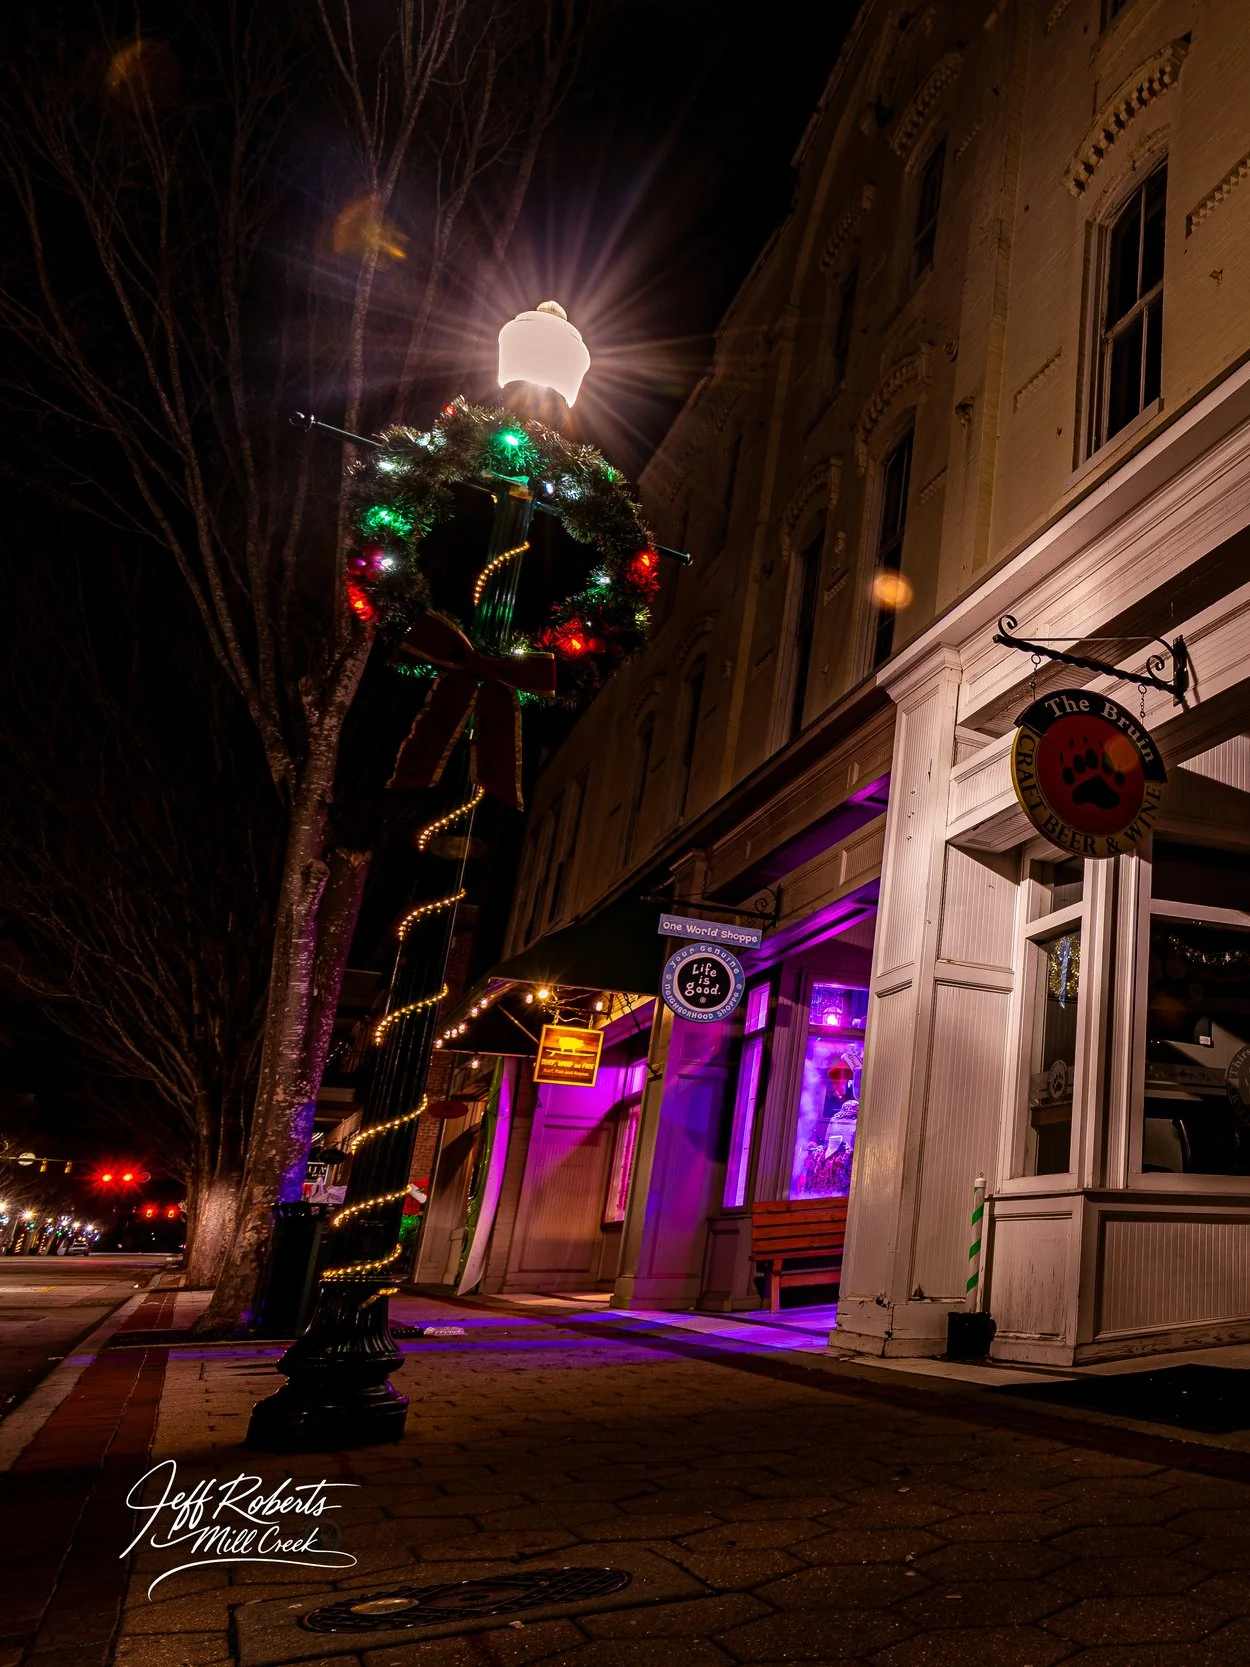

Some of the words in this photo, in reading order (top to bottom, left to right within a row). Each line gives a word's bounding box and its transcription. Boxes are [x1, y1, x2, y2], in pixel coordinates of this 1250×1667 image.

[1045, 695, 1090, 718] The
[1101, 701, 1156, 763] Bruin
[1016, 733, 1048, 817] CRAFT
[1042, 816, 1097, 855] BEER
[1105, 837, 1121, 854] &
[1125, 786, 1162, 844] WINE
[663, 921, 683, 931] One
[686, 924, 718, 937] World
[720, 930, 758, 944] Shoppe
[692, 962, 717, 977] Life
[698, 975, 710, 985] is
[684, 984, 721, 996] good.
